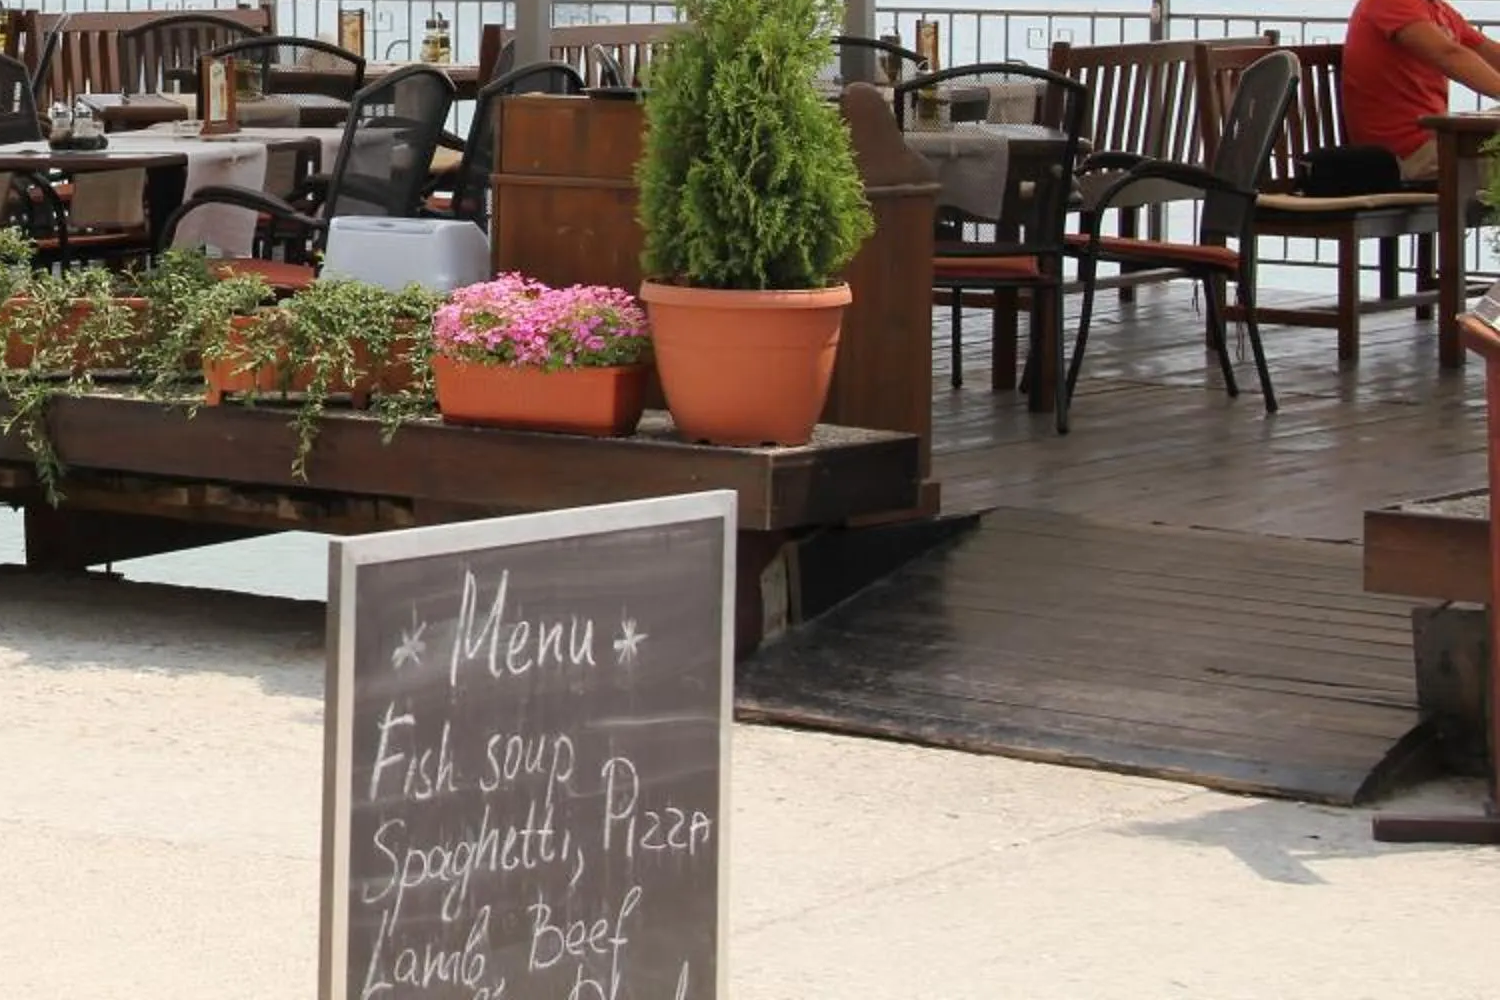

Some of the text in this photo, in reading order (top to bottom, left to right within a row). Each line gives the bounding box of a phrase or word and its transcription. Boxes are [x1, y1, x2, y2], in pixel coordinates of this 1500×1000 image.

[452, 569, 597, 687] Menu
[369, 702, 576, 812] Fish soup
[527, 886, 643, 996] Beef
